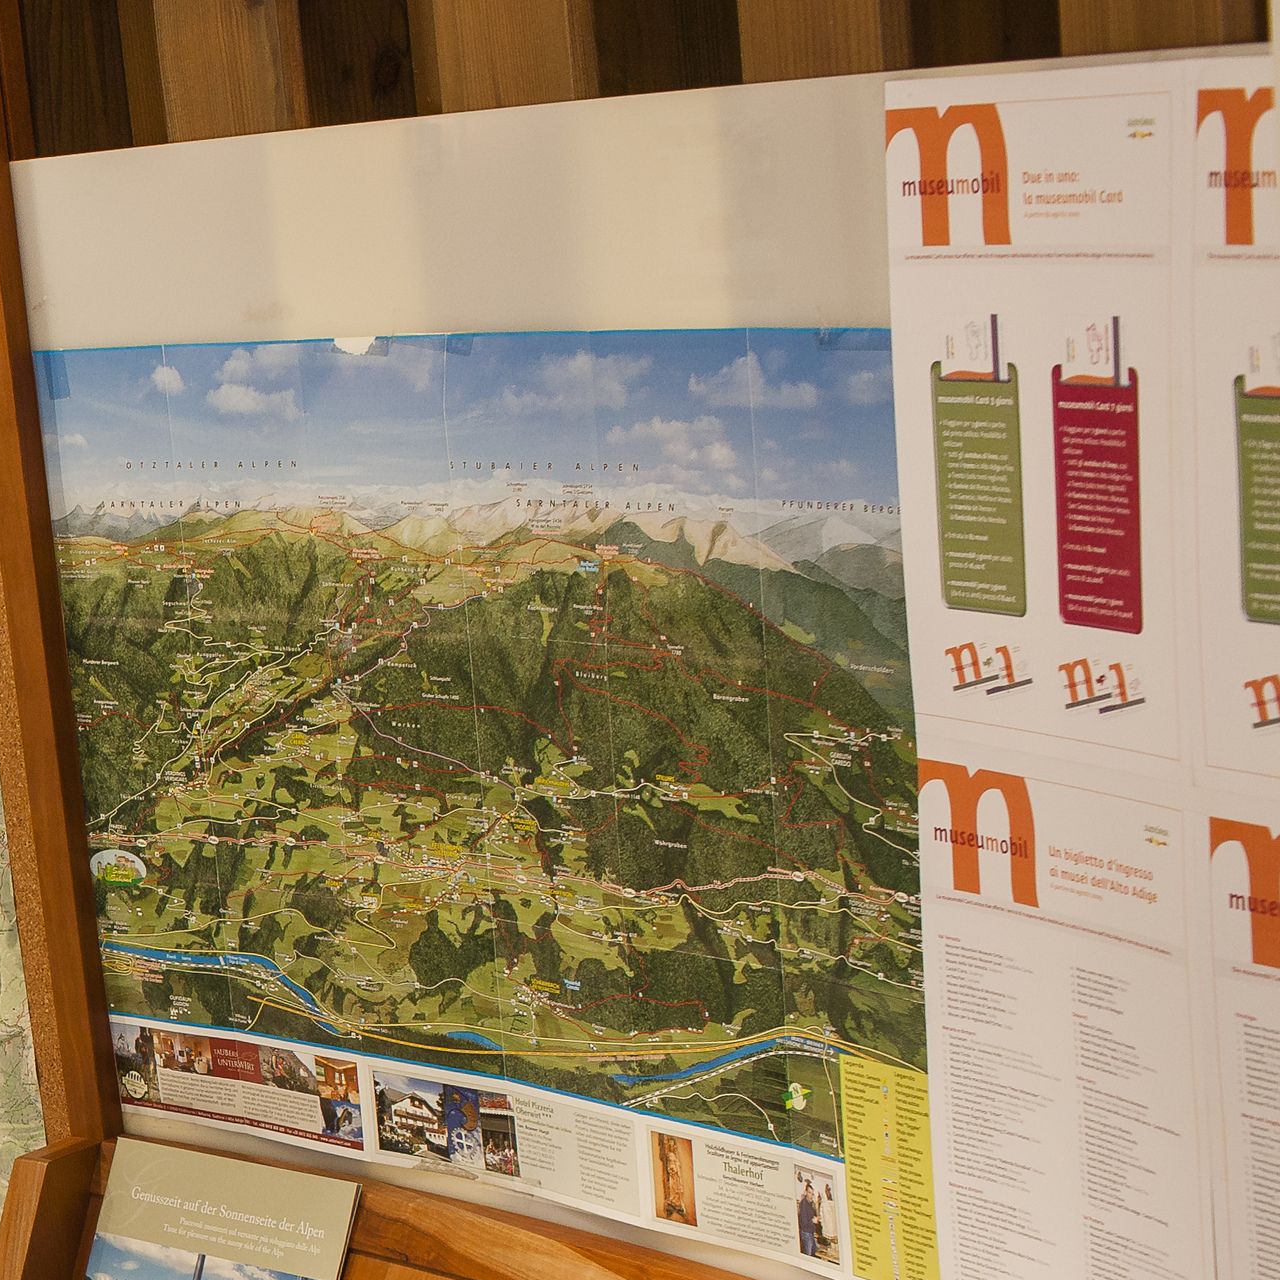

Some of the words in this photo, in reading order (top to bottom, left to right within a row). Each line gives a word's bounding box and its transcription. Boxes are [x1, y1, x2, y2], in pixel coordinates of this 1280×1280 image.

[901, 171, 1001, 197] museumobil
[1022, 171, 1040, 184] Due
[1045, 170, 1055, 183] in
[1058, 171, 1080, 184] uno:
[1036, 192, 1097, 205] museumobil
[1100, 190, 1124, 204] Card
[450, 460, 553, 471] STUBAIER
[575, 462, 640, 472] ALPEN
[196, 500, 241, 509] ALPEN
[516, 498, 611, 511] SARNTALER
[625, 501, 676, 512] ALPEN
[781, 499, 856, 512] PFUNDERER
[933, 825, 1029, 860] museumobil
[1048, 844, 1062, 858] Un
[1064, 847, 1105, 872] biglietto
[1049, 864, 1058, 878] di
[1061, 868, 1090, 886] musei
[1091, 874, 1129, 896] dell'Alto
[1132, 886, 1158, 904] Adige
[213, 1048, 240, 1058] TAUBERS
[515, 1097, 530, 1109] Hotel
[131, 1186, 182, 1210] Genusszeit
[183, 1200, 200, 1212] auf
[201, 1201, 218, 1216] der
[219, 1205, 277, 1230] Sonnenseite
[279, 1217, 296, 1232] der
[297, 1220, 325, 1240] Alpen
